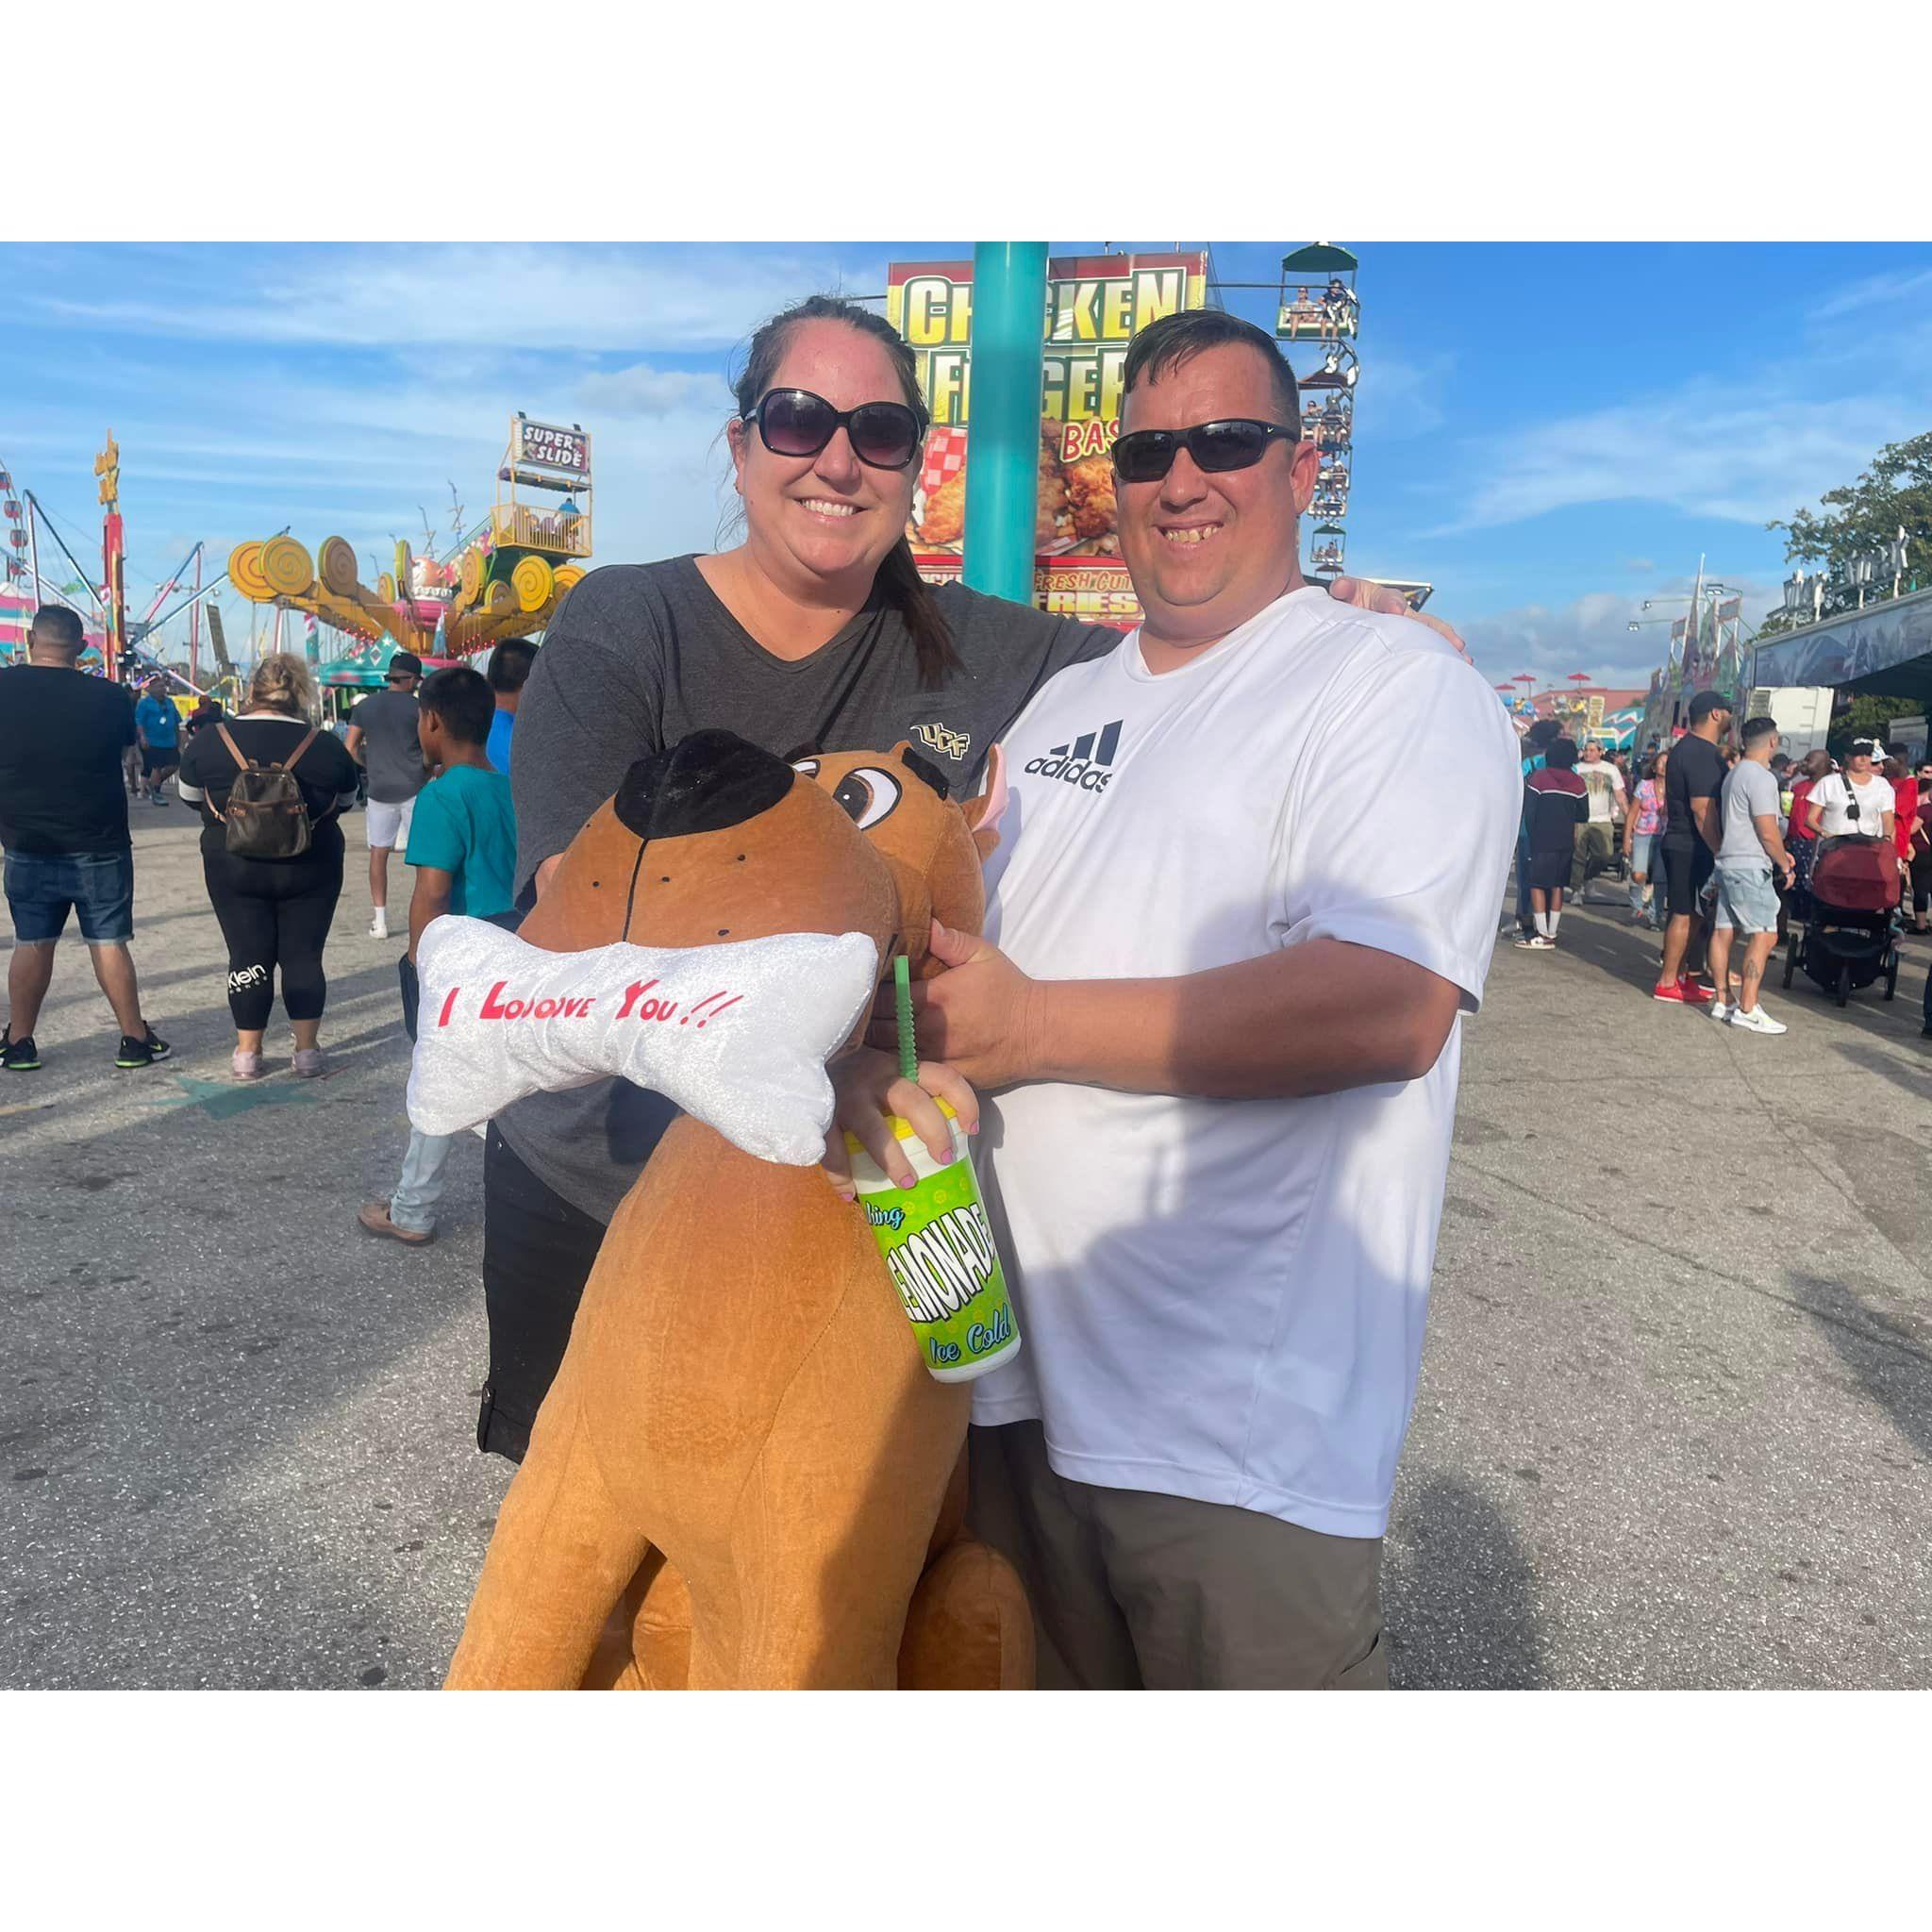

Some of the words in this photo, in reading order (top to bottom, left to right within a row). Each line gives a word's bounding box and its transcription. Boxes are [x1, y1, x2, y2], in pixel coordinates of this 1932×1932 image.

[908, 271, 1178, 344] CHKEN
[524, 426, 575, 450] SUPER
[537, 445, 582, 467] SLIDE
[1060, 418, 1120, 462] BAS
[1032, 591, 1141, 613] FRIES
[910, 723, 971, 760] UCF
[1024, 756, 1113, 793] adidas
[228, 964, 266, 990] Klein
[438, 987, 461, 1027] I
[930, 1337, 960, 1364] Ice
[967, 1304, 1011, 1353] Cold
